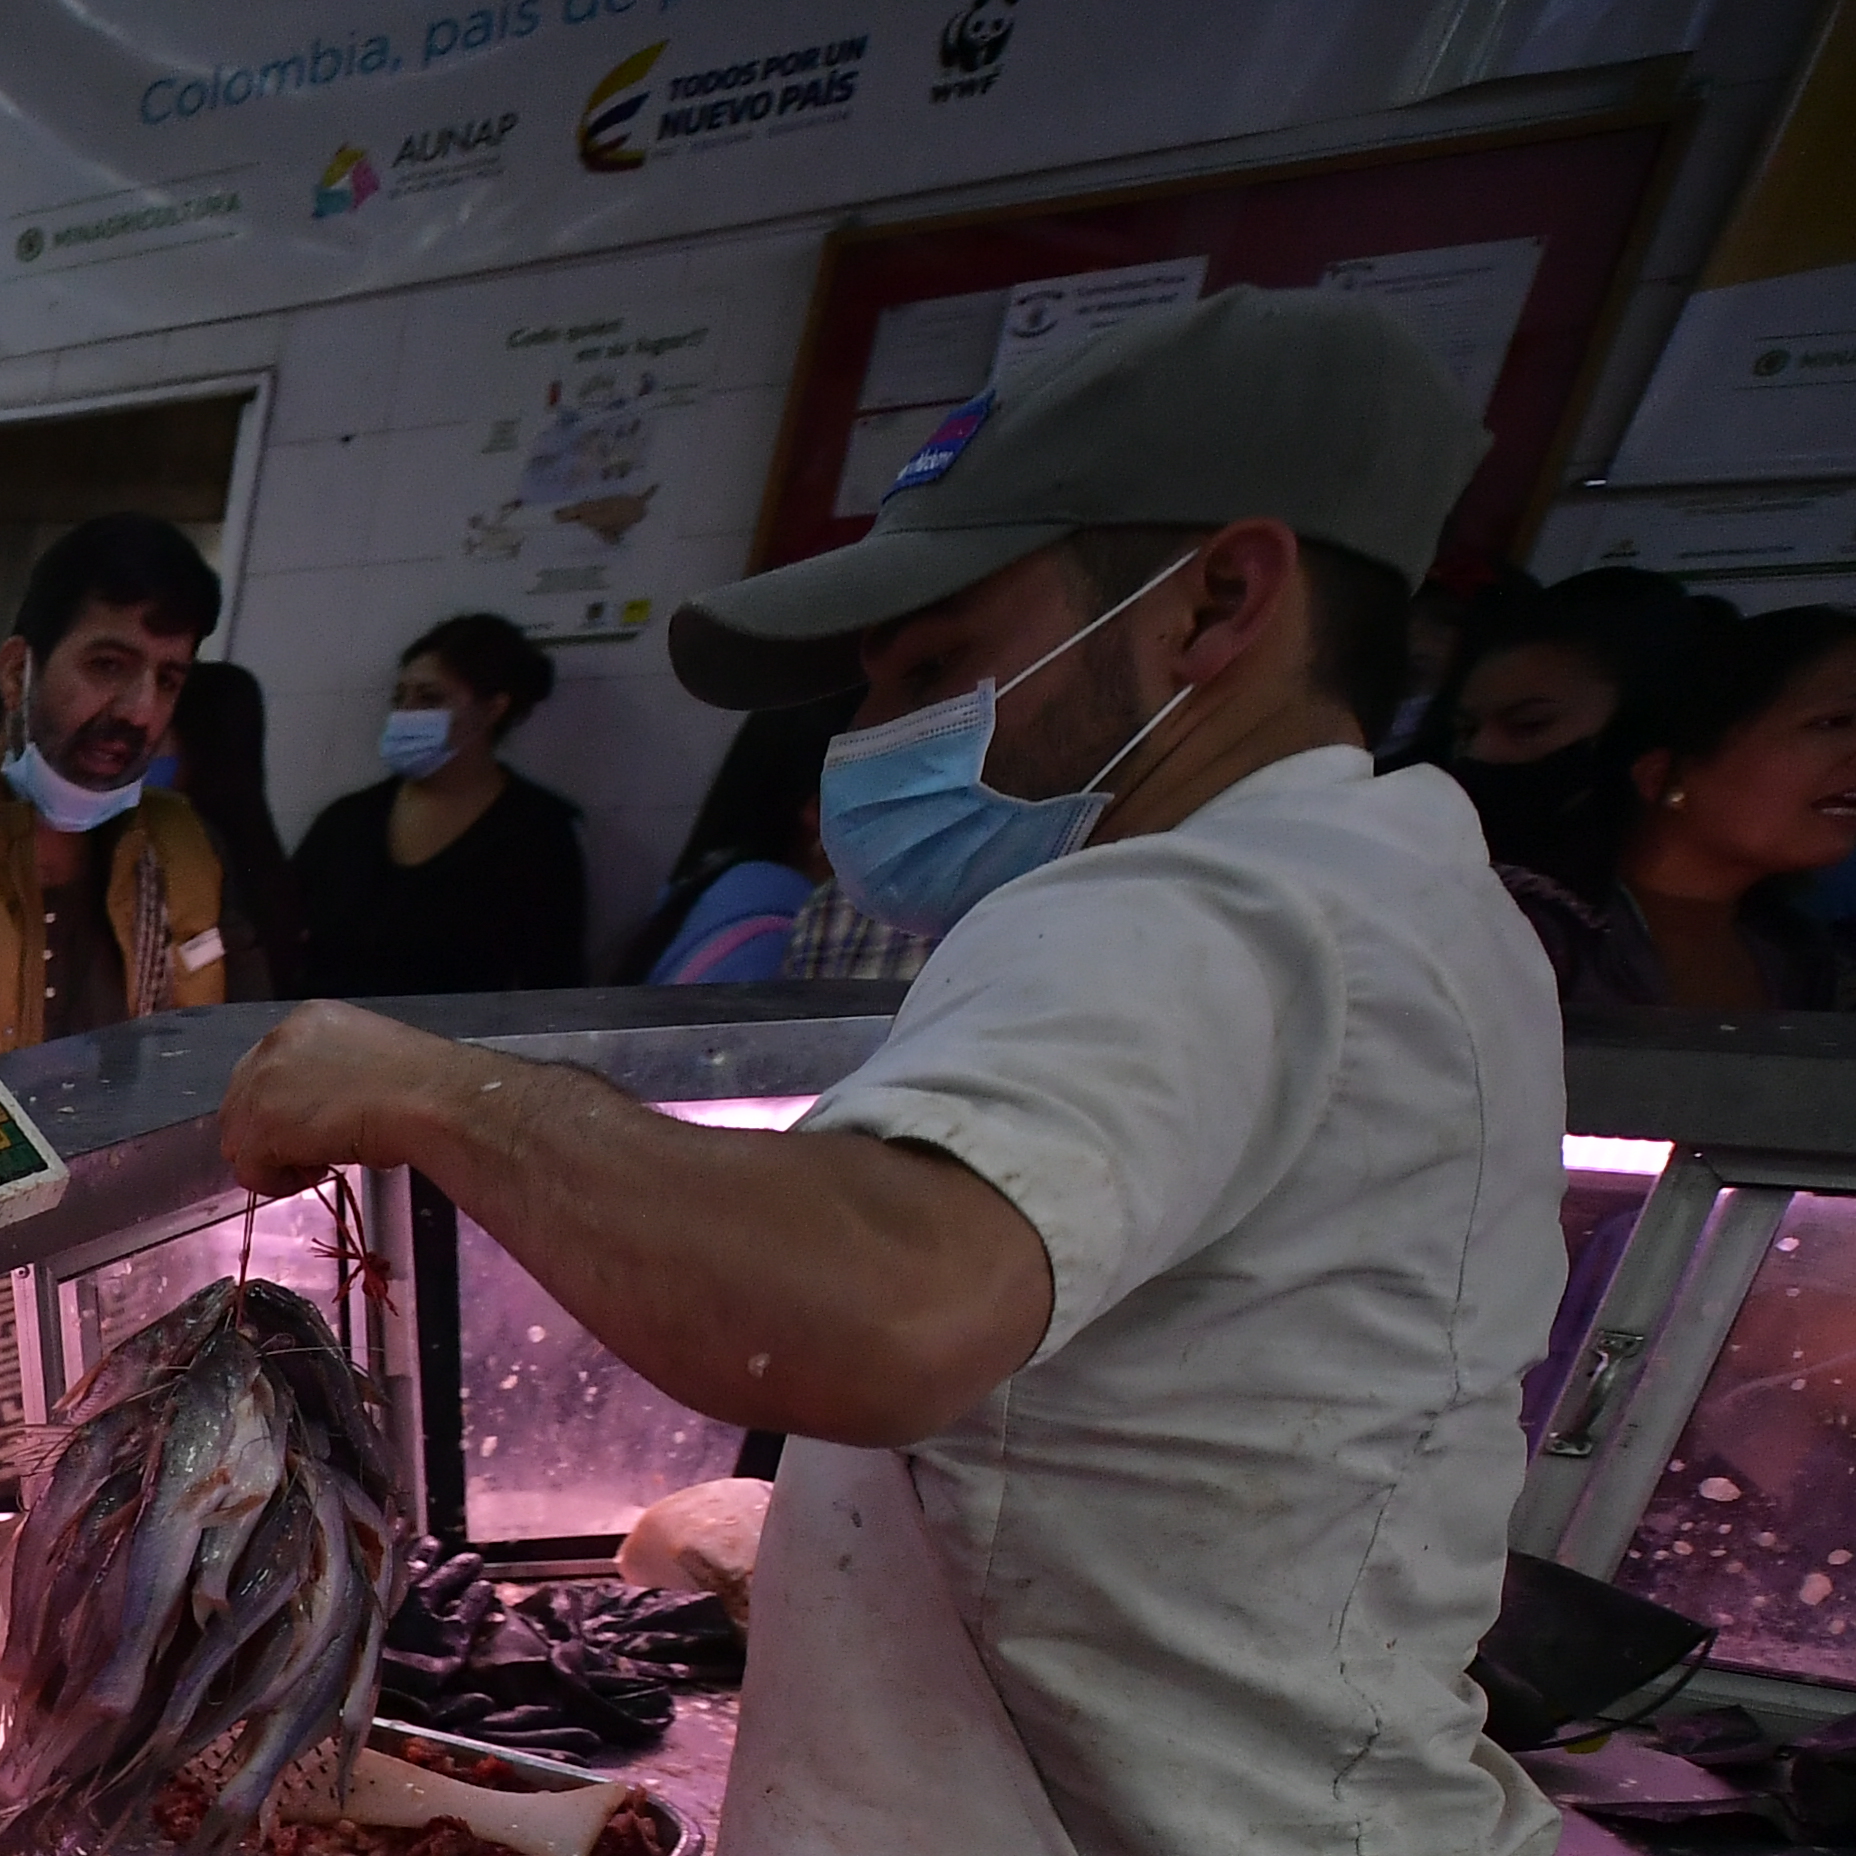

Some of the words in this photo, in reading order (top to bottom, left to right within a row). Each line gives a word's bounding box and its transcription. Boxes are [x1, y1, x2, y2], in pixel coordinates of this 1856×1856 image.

[139, 29, 401, 126] Colombia,
[671, 60, 759, 101] TODOS
[761, 48, 821, 82] POR
[822, 34, 870, 67] UN
[392, 111, 521, 168] AUNAP
[658, 88, 773, 141] NUEVO
[776, 69, 860, 116] PAÍS
